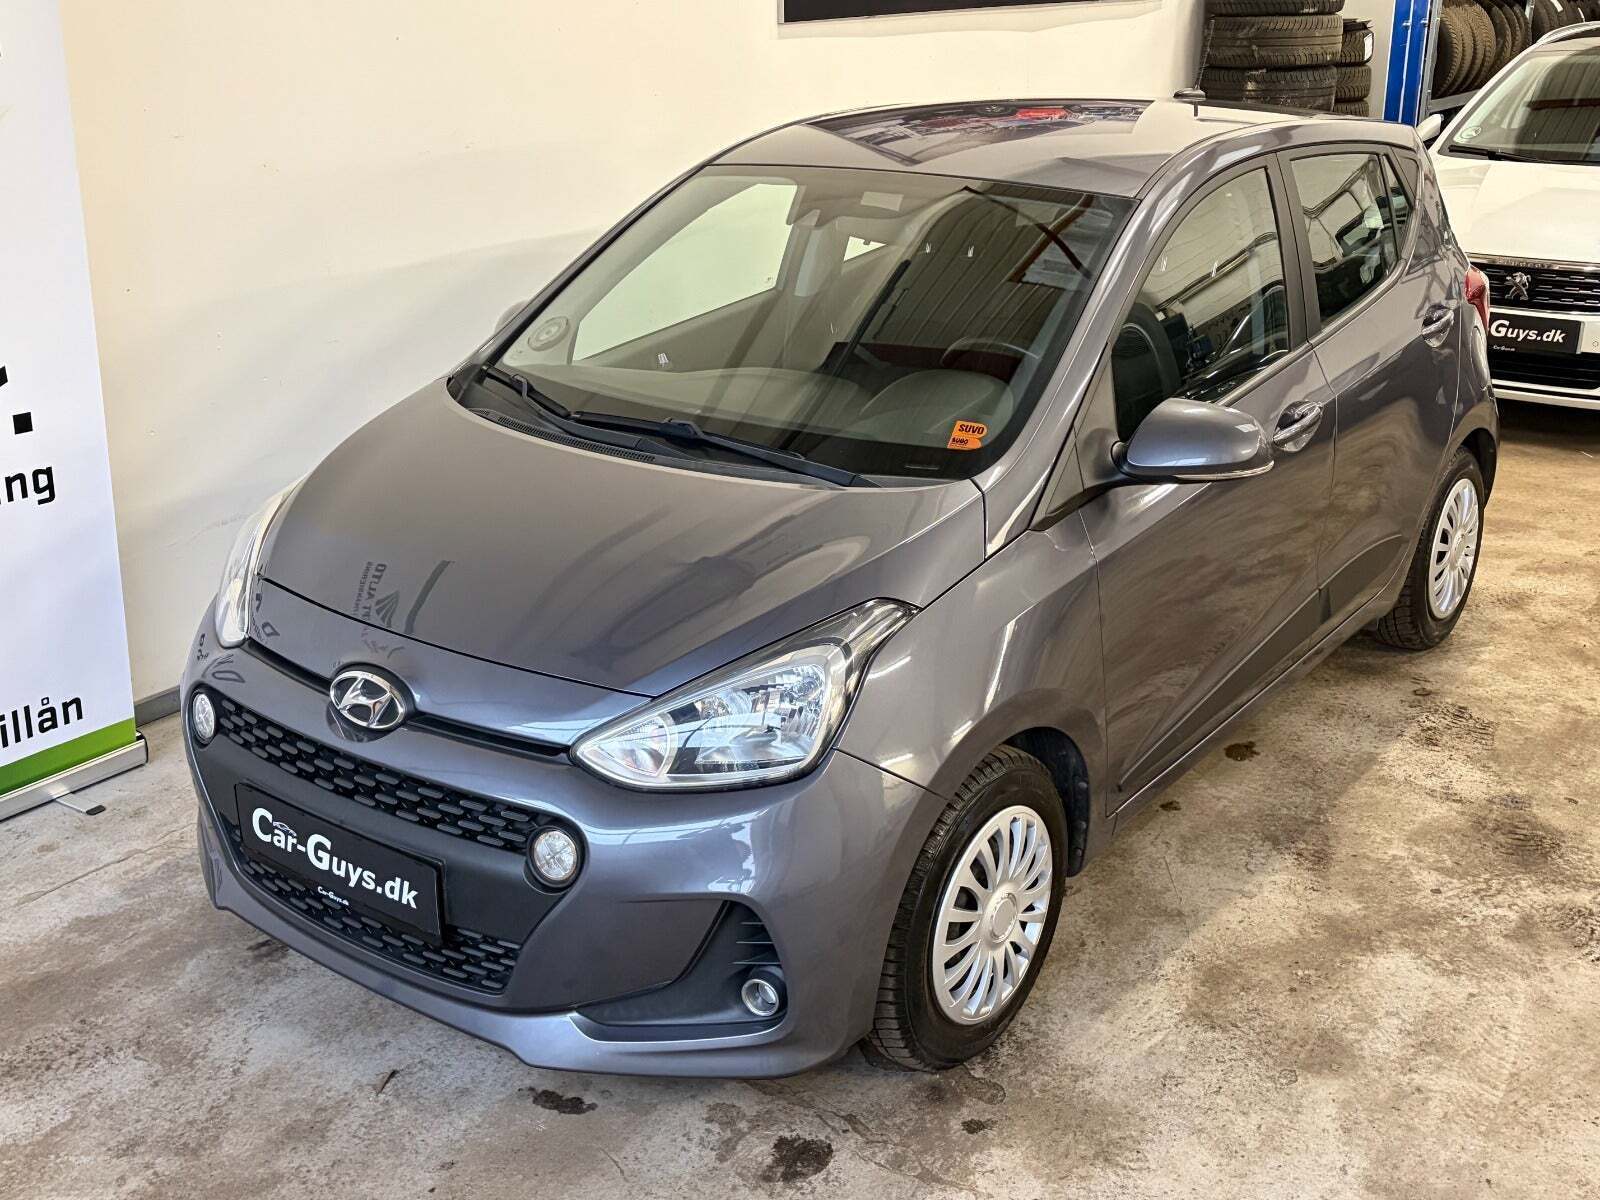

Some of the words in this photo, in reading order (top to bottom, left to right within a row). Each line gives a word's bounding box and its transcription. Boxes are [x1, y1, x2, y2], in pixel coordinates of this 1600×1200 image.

[1490, 320, 1567, 343] Guys.dk
[958, 424, 985, 435] SUVO
[0, 466, 56, 506] ng
[252, 807, 419, 909] Car-Guys.dk
